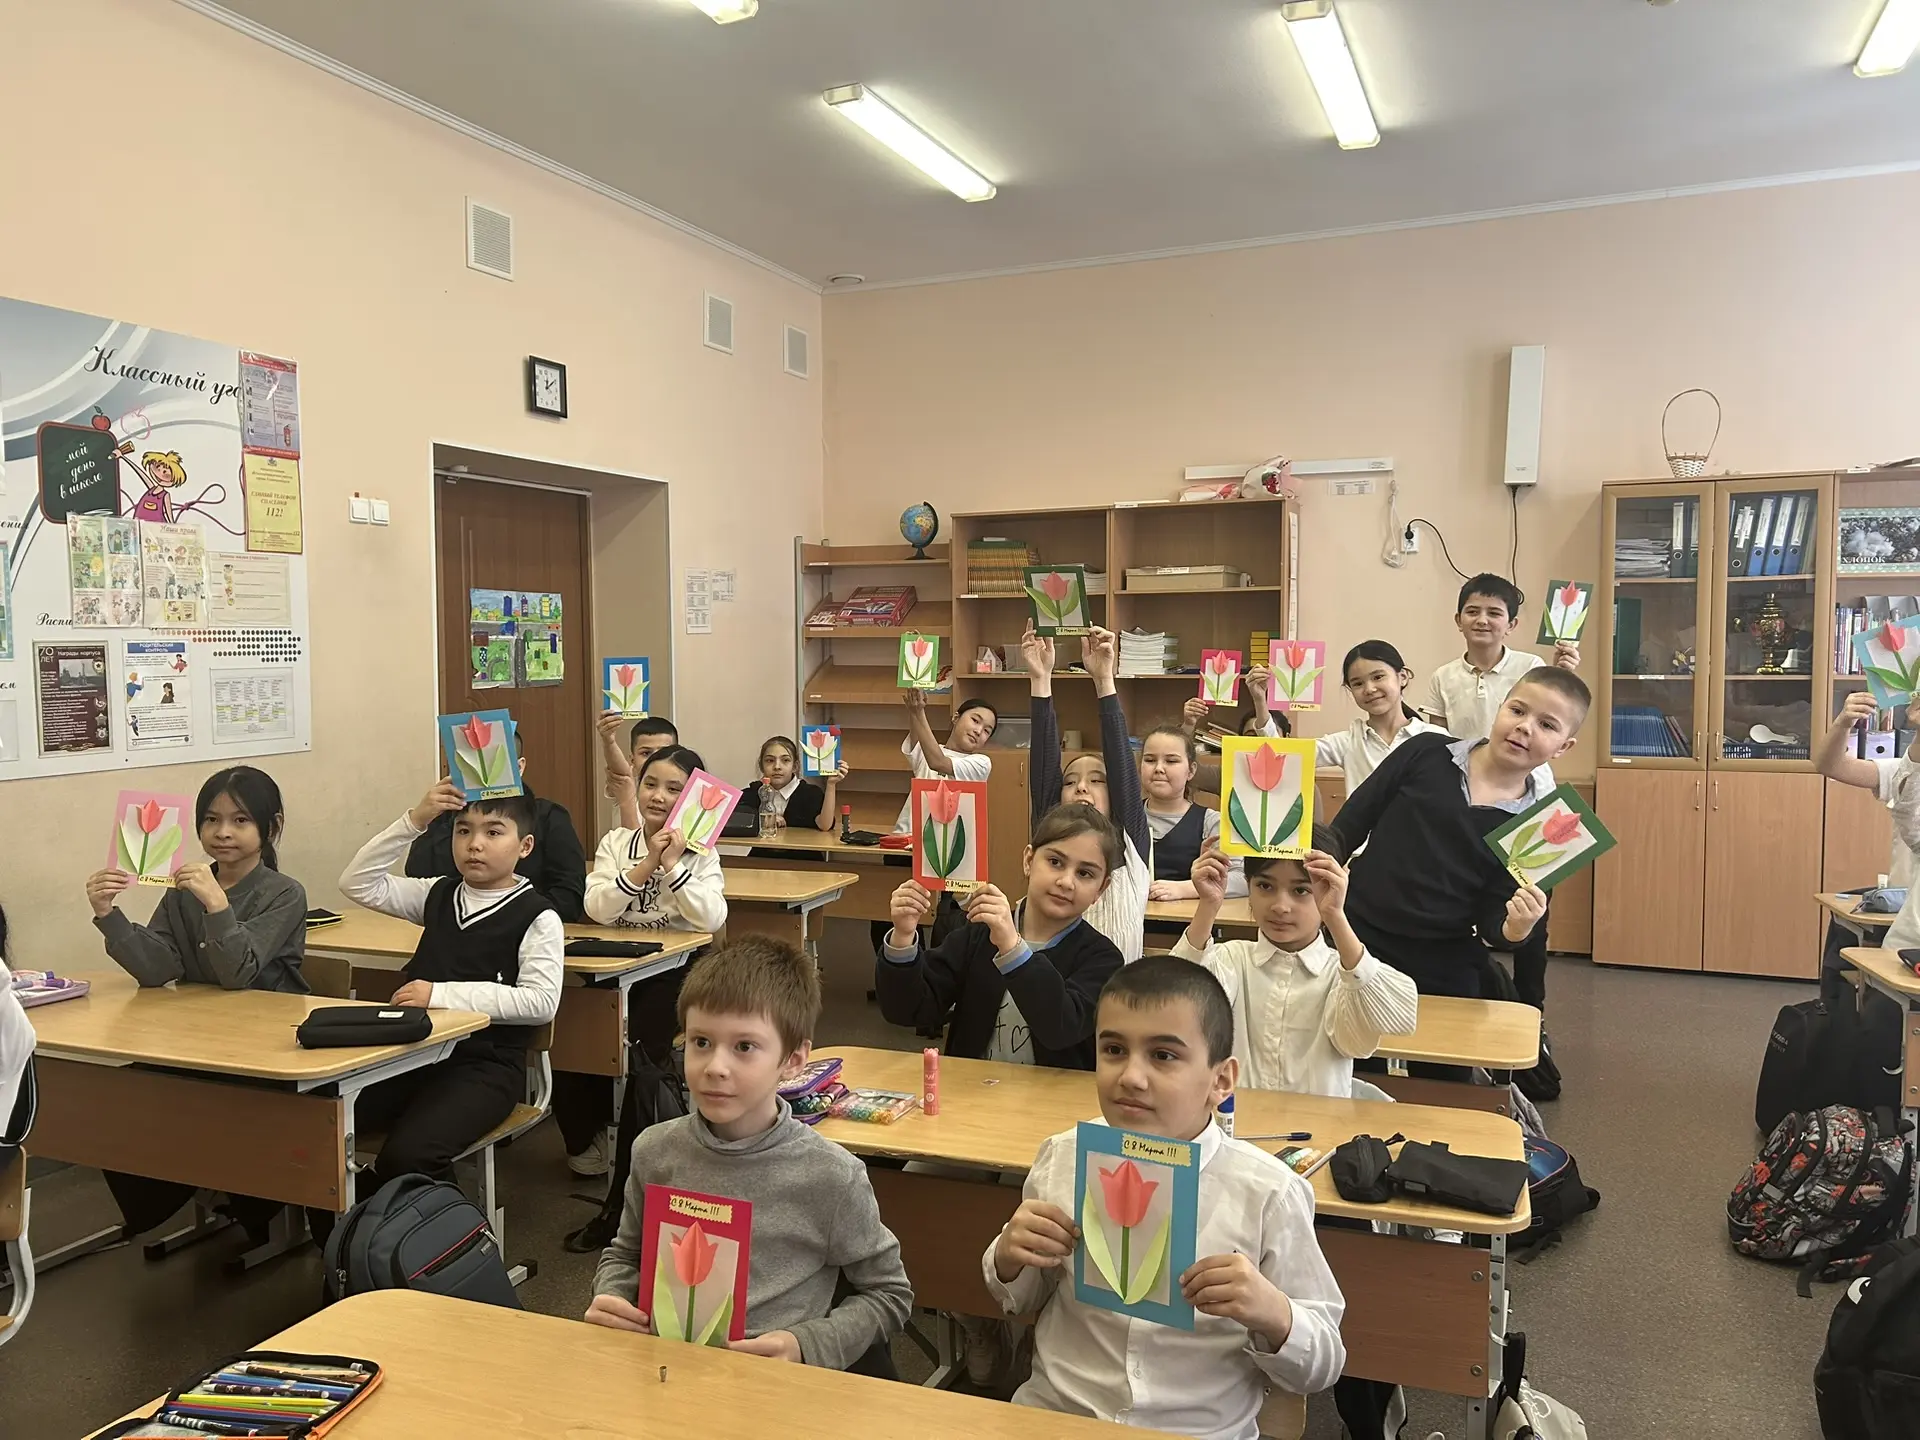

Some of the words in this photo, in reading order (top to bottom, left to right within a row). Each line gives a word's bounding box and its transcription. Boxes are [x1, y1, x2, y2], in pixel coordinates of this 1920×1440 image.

[84, 346, 207, 392] Классный
[66, 442, 88, 463] мой
[71, 460, 95, 483] день
[60, 484, 67, 499] в
[69, 473, 102, 495] школе
[266, 507, 284, 517] 112!
[36, 612, 72, 626] Распи
[40, 647, 54, 656] 70
[1273, 847, 1293, 855] Марта
[1124, 1140, 1130, 1150] С
[1132, 1140, 1137, 1150] 8
[1139, 1143, 1164, 1156] Марта
[1166, 1147, 1177, 1158] !!!
[671, 1198, 677, 1207] С
[678, 1198, 684, 1208] 8
[684, 1202, 708, 1215] Марта
[710, 1205, 720, 1216] !!!
